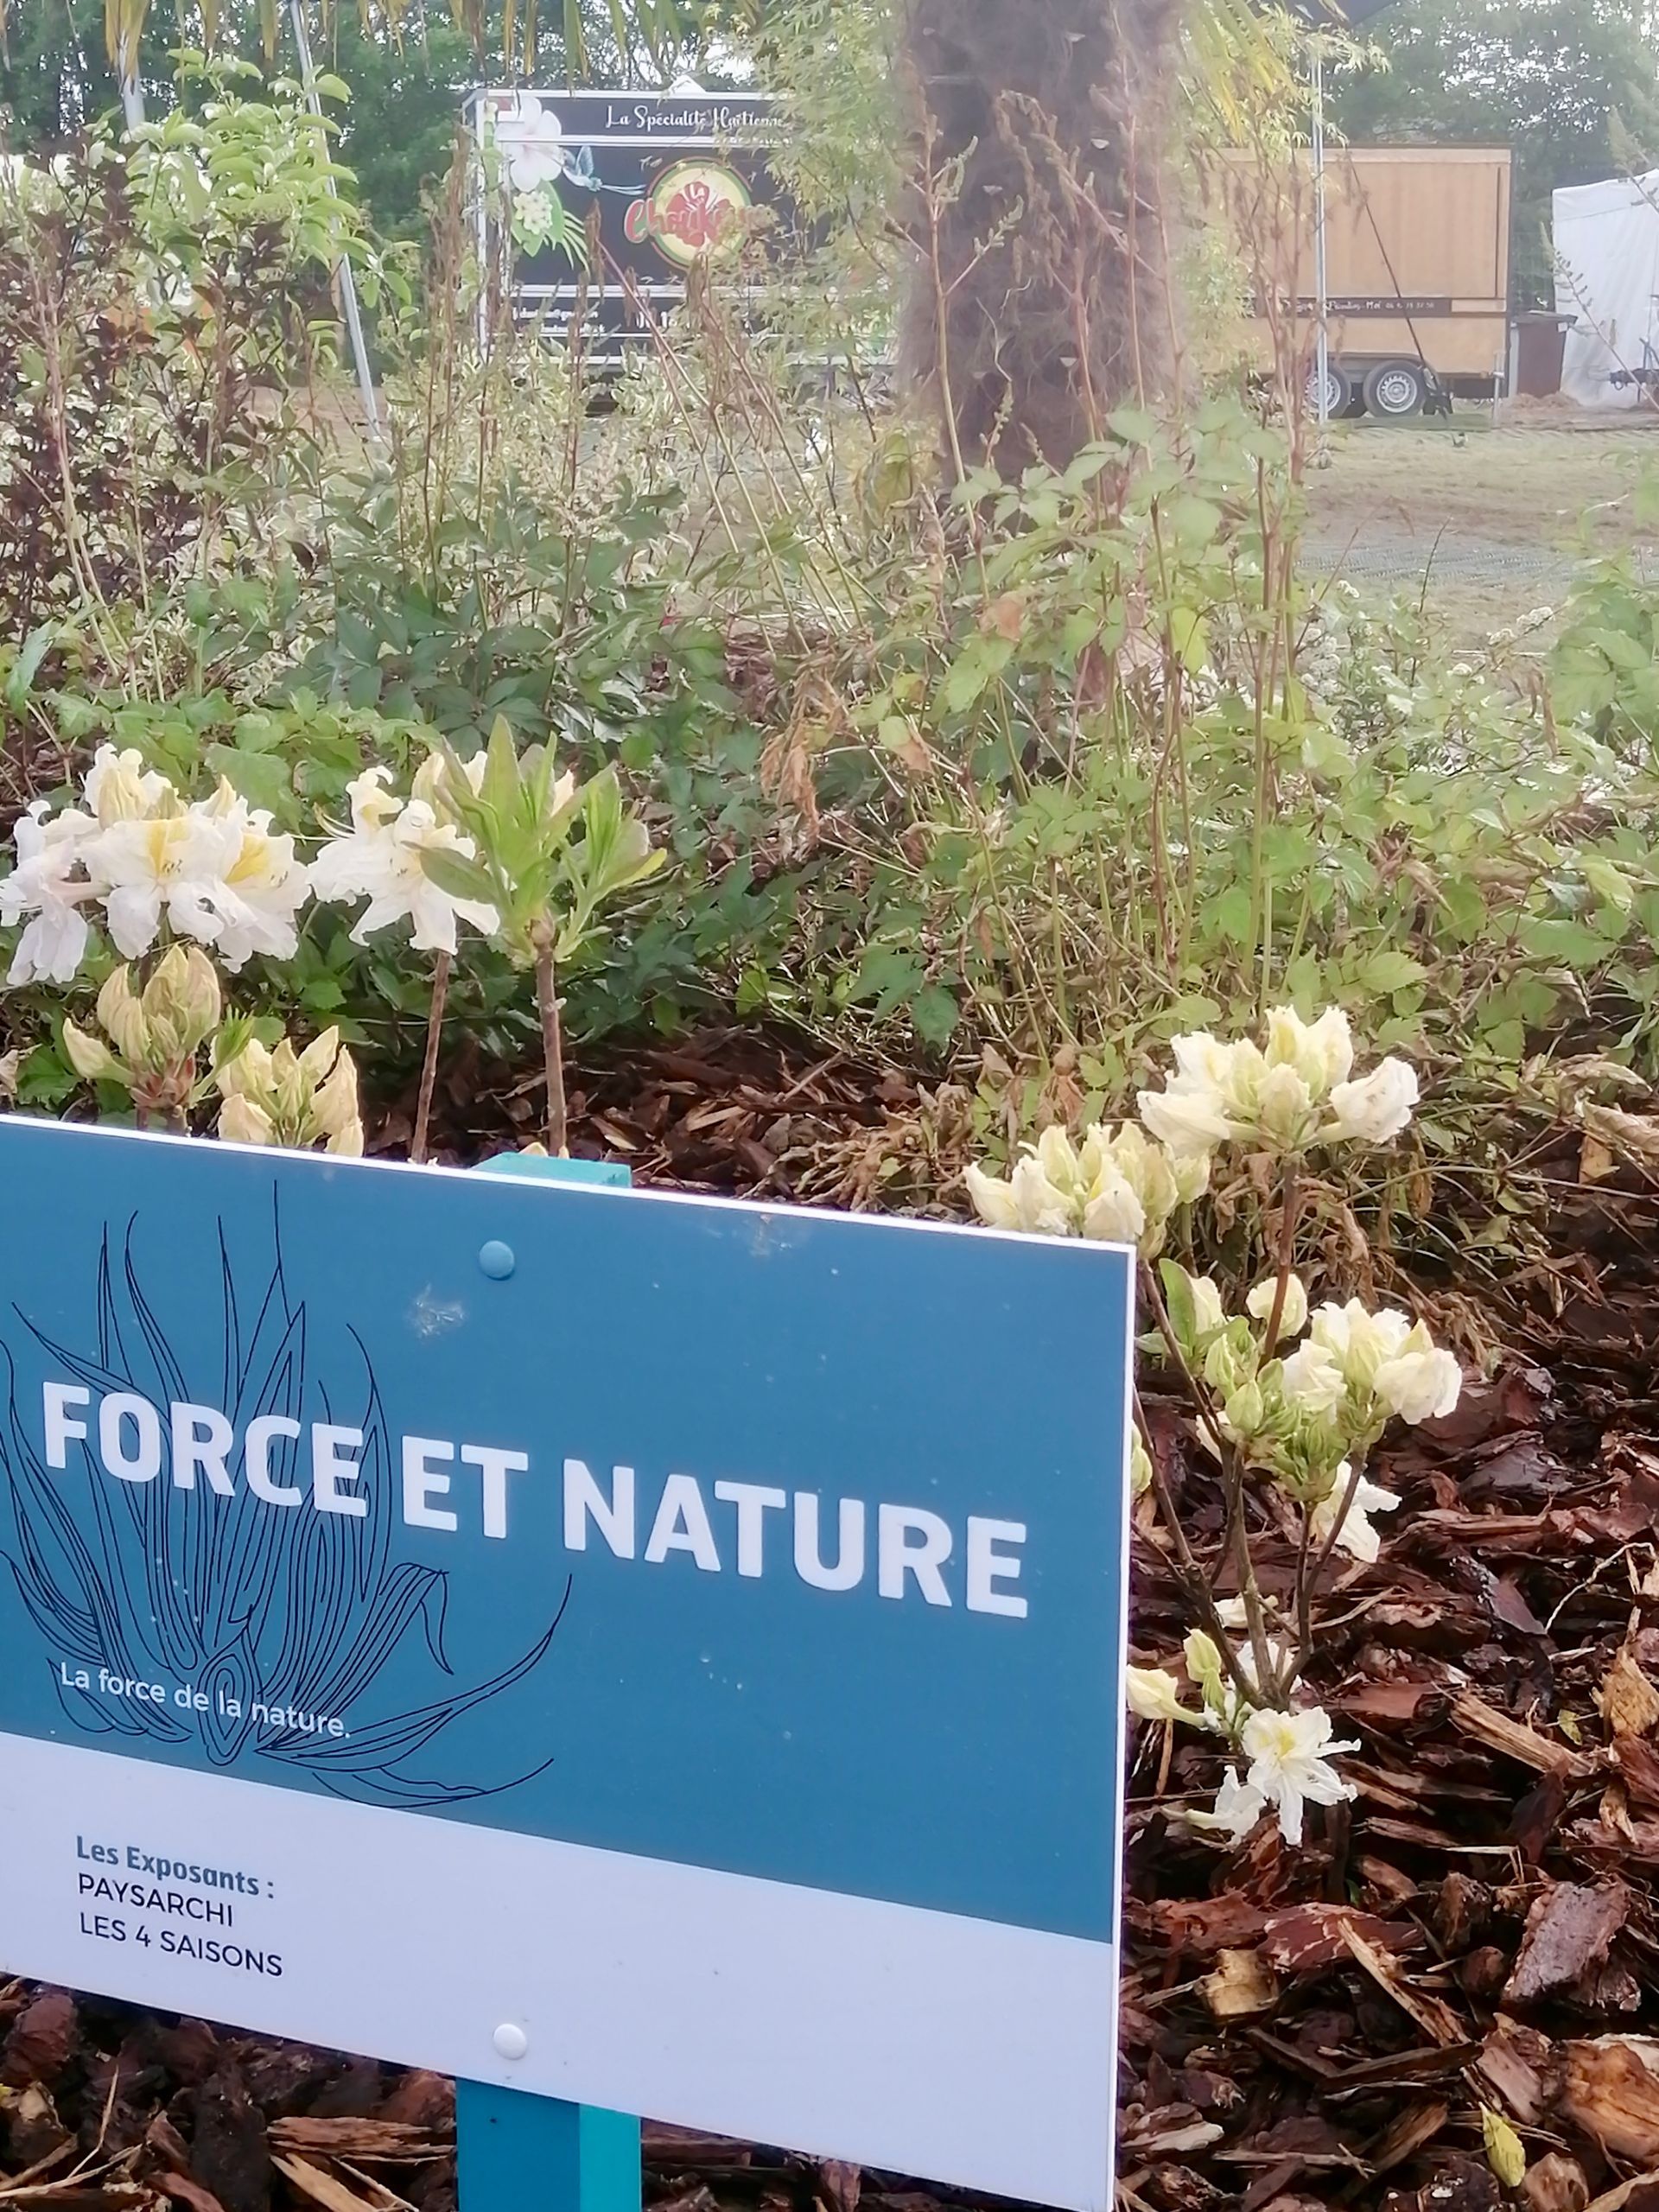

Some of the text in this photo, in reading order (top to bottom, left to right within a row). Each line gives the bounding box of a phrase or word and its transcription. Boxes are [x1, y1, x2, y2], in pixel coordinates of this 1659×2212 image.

[606, 105, 630, 128] La
[42, 1381, 1028, 1618] FORCE ET NATURE
[60, 1662, 351, 1738] La force de la nature.
[76, 1835, 119, 1866] Les
[126, 1846, 259, 1896] Exposants
[79, 1872, 233, 1927] PAYSARCHI
[80, 1912, 283, 1977] LES 4 SAISONS
